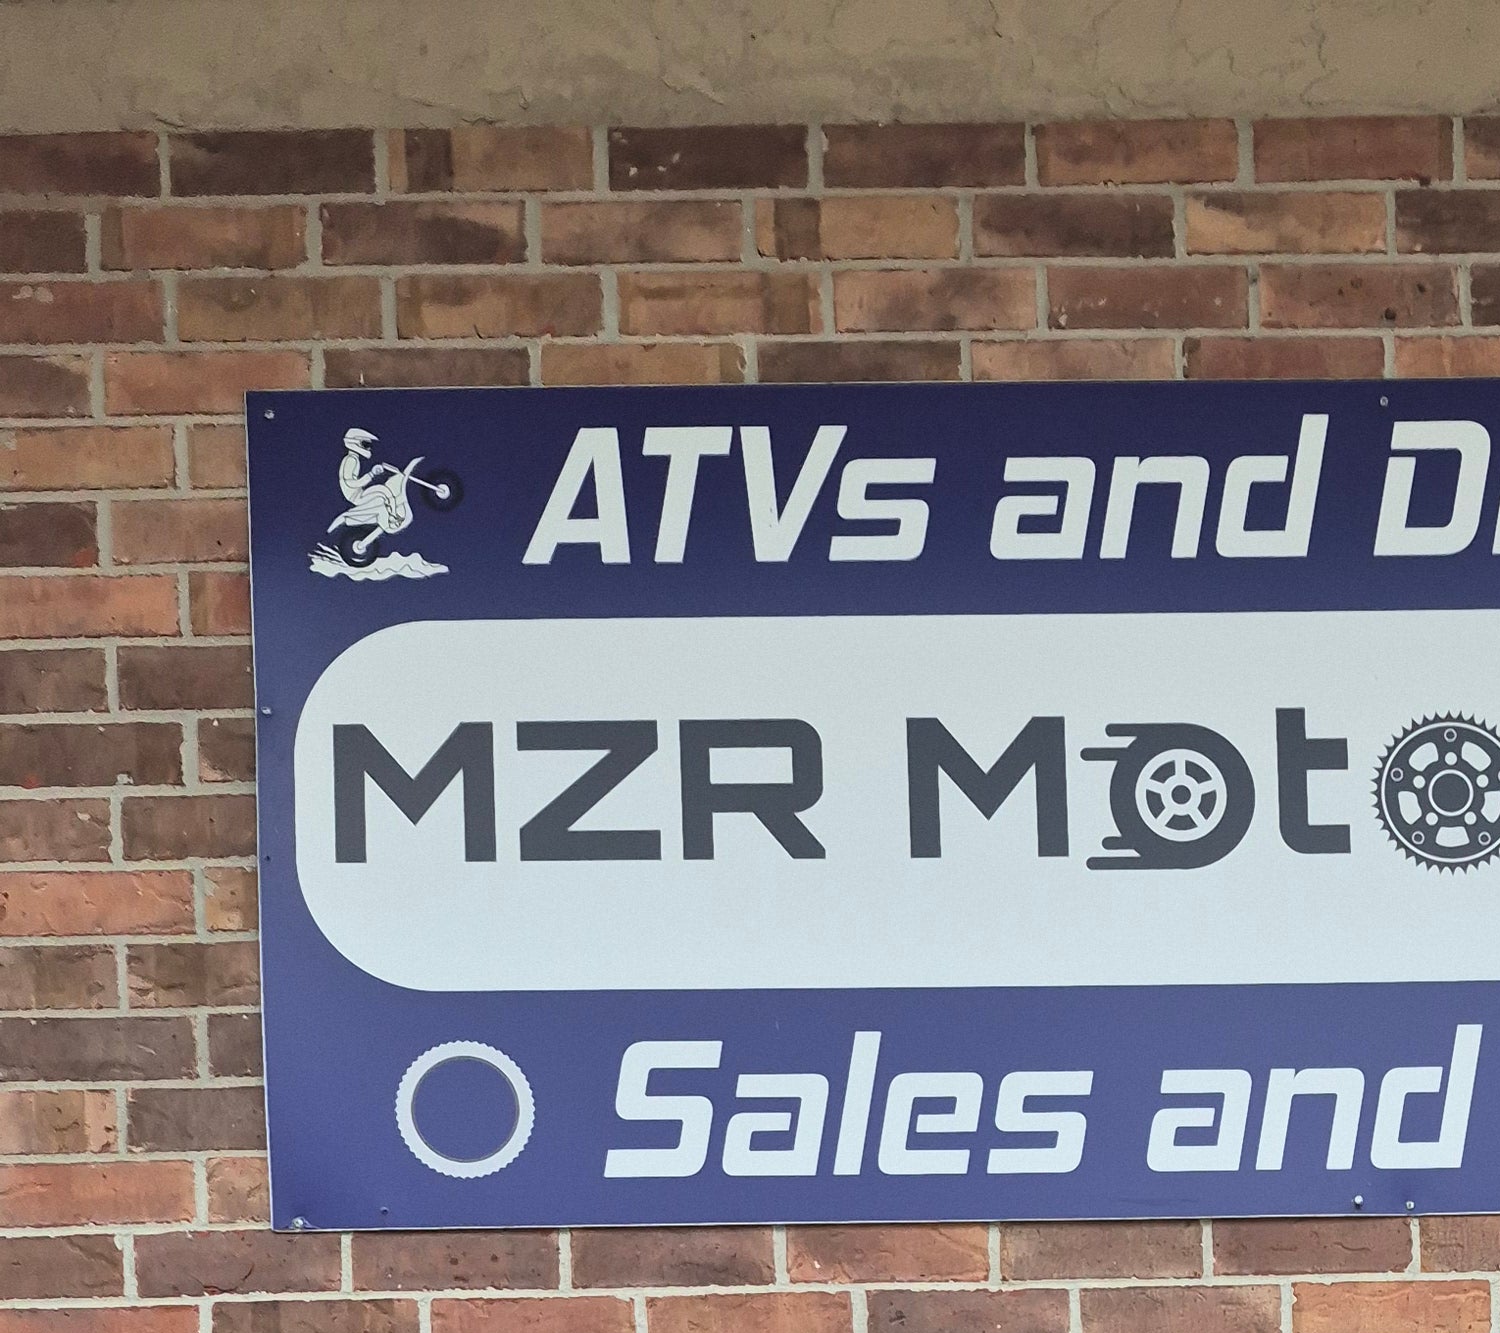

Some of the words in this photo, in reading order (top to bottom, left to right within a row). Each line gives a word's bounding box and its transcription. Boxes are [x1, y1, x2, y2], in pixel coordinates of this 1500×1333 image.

[521, 425, 937, 566] ATVs
[989, 413, 1330, 560] and
[332, 718, 826, 864] MZR
[603, 1030, 1094, 1178] Sales
[1146, 1023, 1483, 1172] and
